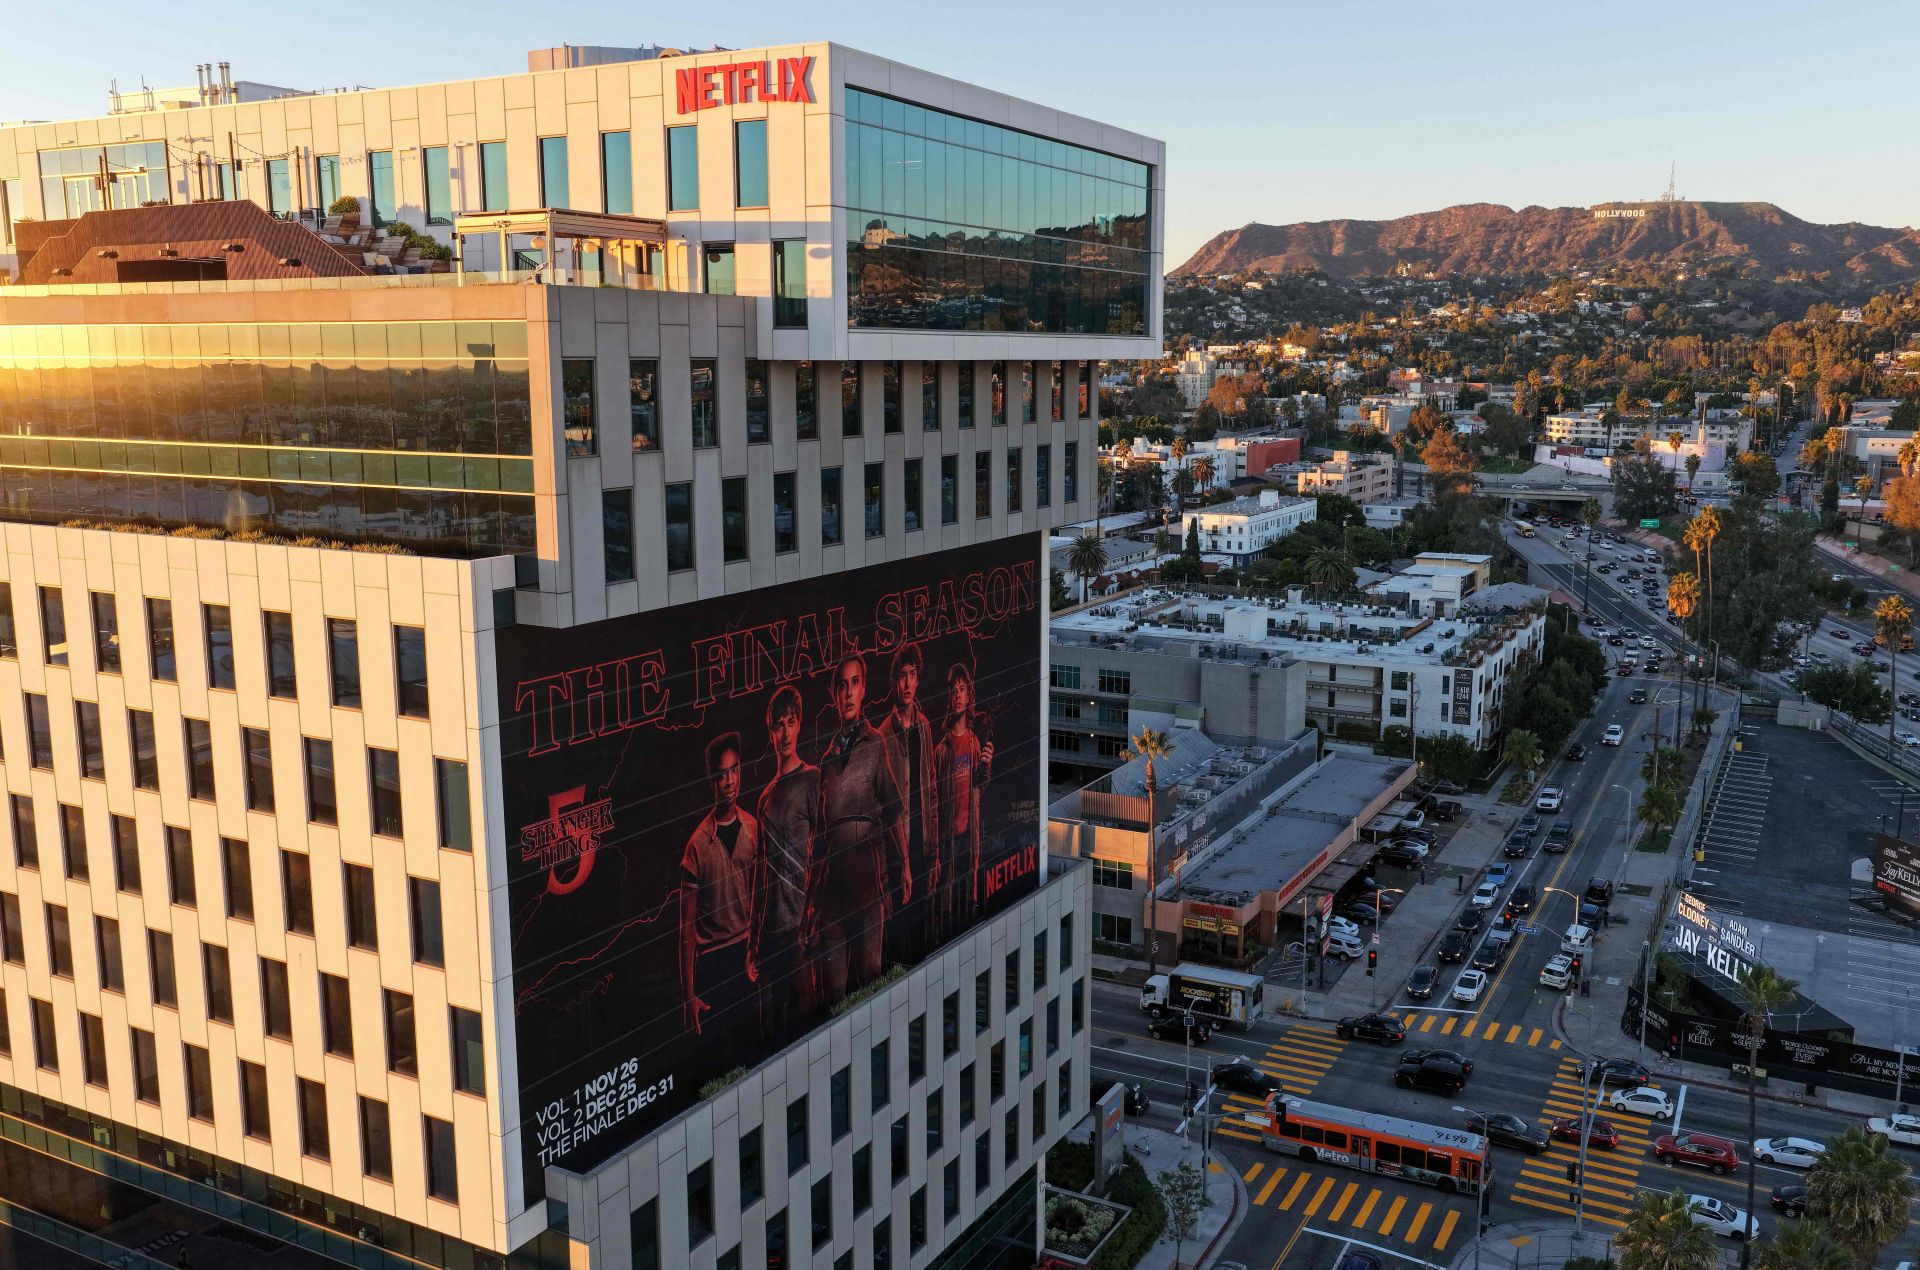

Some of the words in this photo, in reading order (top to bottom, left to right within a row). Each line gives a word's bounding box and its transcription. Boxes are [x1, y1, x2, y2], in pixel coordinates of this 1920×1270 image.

[676, 56, 811, 114] NETFLIX
[1594, 209, 1645, 218] HOLLYWOOD
[516, 650, 670, 757] THE
[692, 607, 859, 709] FINAL
[875, 560, 1035, 656] SEASON
[521, 802, 615, 857] STRANGER
[547, 784, 597, 895] 5
[540, 829, 601, 870] THINGS
[986, 843, 1036, 898] NETFLIX
[1678, 902, 1710, 929] CLOONEY
[1684, 893, 1707, 912] GEORGE
[1675, 925, 1700, 957] JAY
[1720, 927, 1756, 957] SANDLER
[1729, 919, 1748, 938] ADAM
[1180, 986, 1216, 999] ROCKSTAR
[1688, 1033, 1715, 1047] KELLY
[1850, 1053, 1872, 1065] ALL
[1873, 1058, 1885, 1067] MY
[1866, 1065, 1881, 1074] ARE
[535, 1098, 570, 1126] VOL
[573, 1089, 580, 1105] 1
[585, 1068, 618, 1100] NOV
[620, 1057, 639, 1080] 26
[537, 1118, 571, 1147] VOL
[573, 1108, 583, 1127] 2
[586, 1089, 617, 1120] DEC
[619, 1077, 637, 1101] 25
[537, 1135, 571, 1167] THE
[573, 1102, 626, 1148] FINALE
[627, 1085, 657, 1115] DEC
[658, 1074, 674, 1096] 31
[1313, 1146, 1350, 1164] Metro
